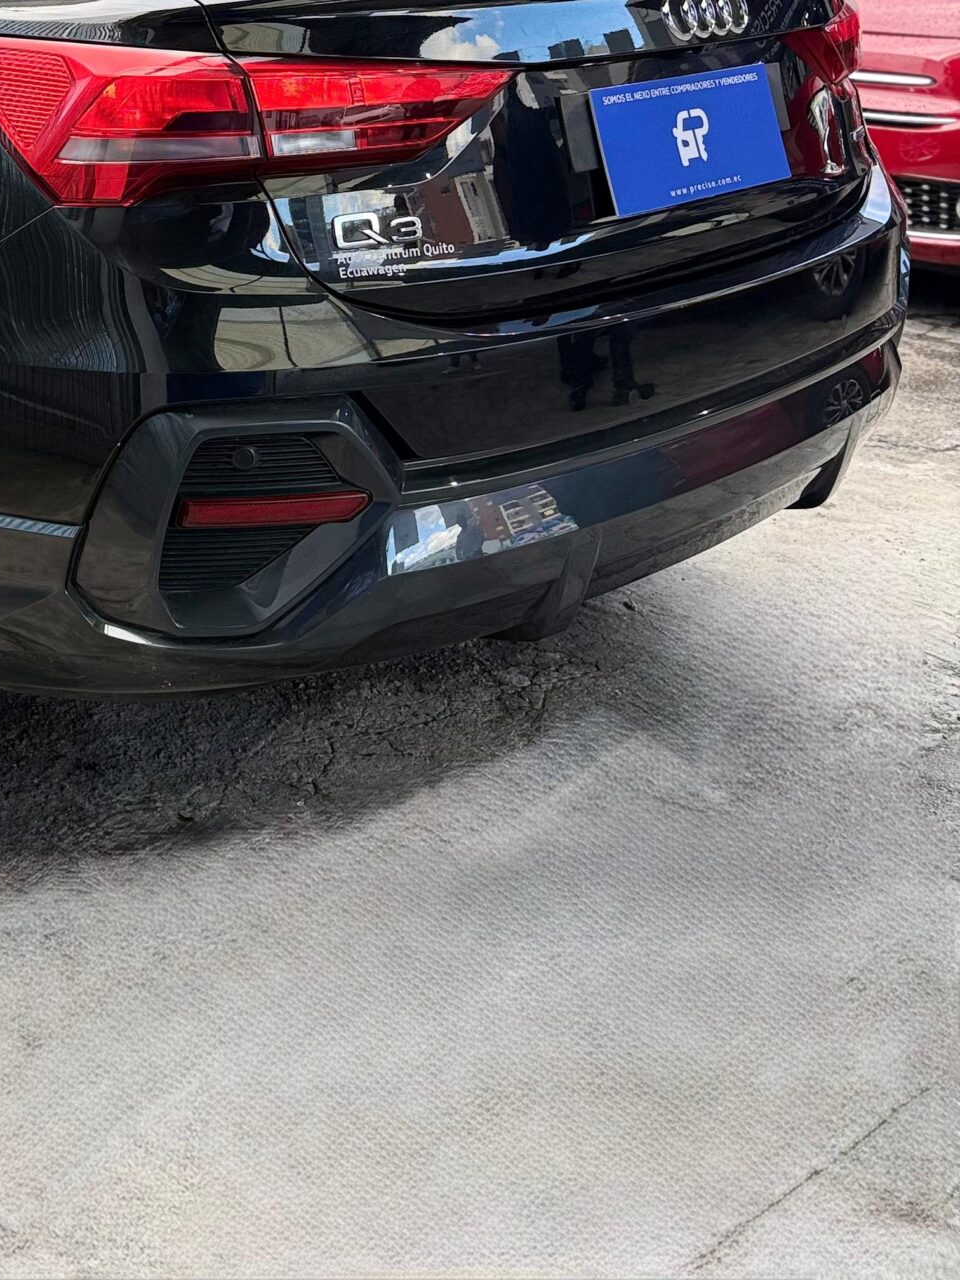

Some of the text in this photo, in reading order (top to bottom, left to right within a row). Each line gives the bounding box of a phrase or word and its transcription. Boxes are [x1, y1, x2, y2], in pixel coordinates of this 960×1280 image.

[602, 93, 626, 105] SOMOS
[626, 91, 634, 102] EL
[634, 89, 650, 100] NEXO
[651, 86, 670, 98] ENTRE
[670, 80, 715, 94] COMPRADORES
[720, 72, 758, 86] VENDEDORES
[670, 174, 742, 197] www.preciso.com.ec
[423, 243, 455, 256] Quito
[339, 263, 407, 279] Ecuawagen
